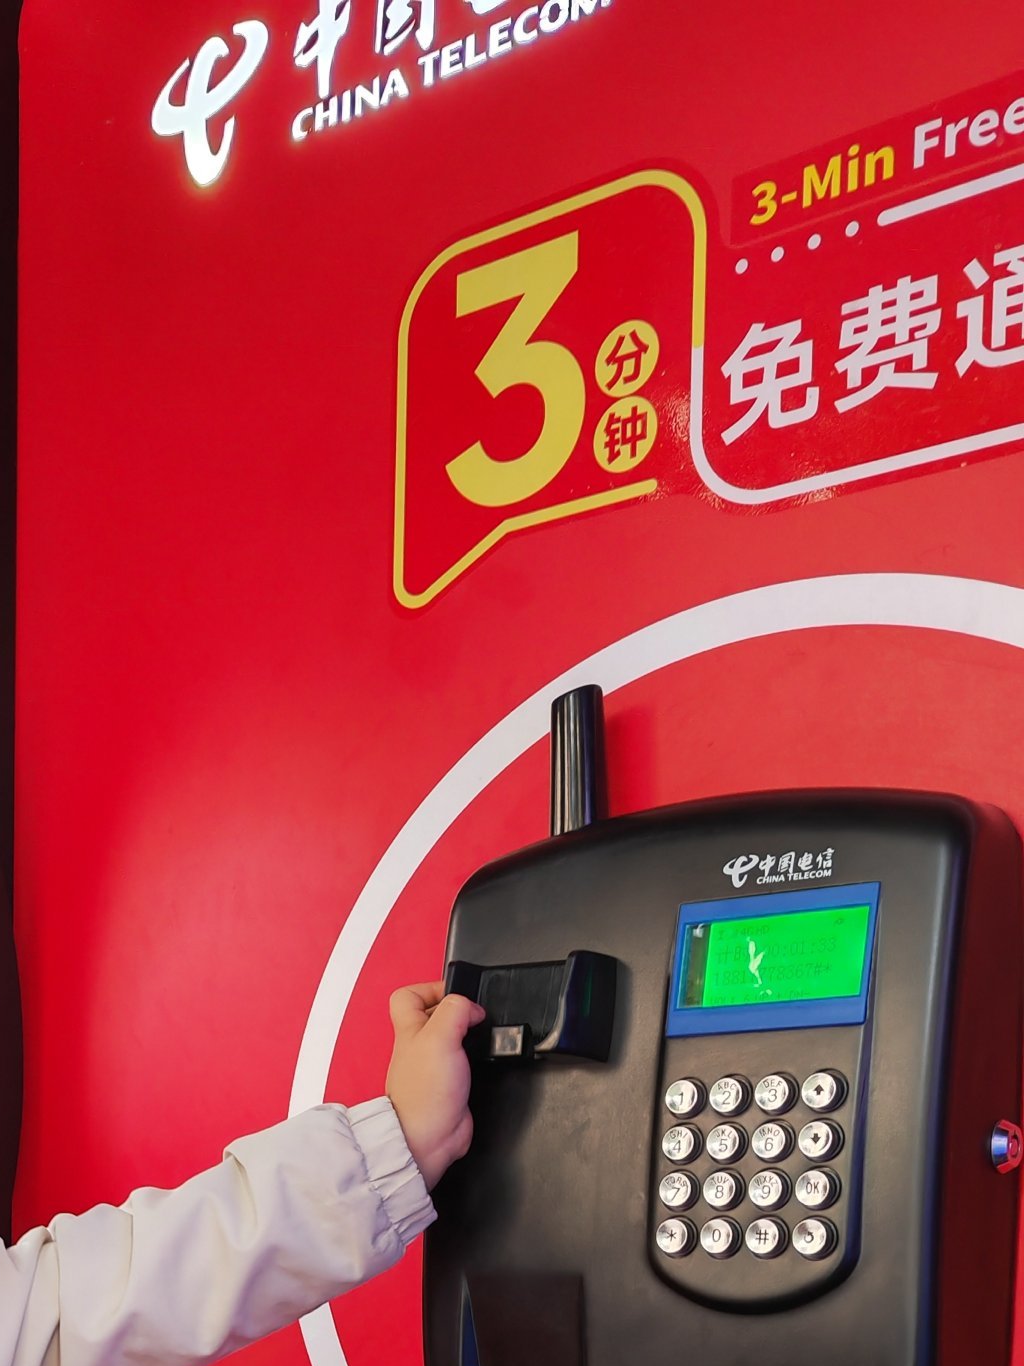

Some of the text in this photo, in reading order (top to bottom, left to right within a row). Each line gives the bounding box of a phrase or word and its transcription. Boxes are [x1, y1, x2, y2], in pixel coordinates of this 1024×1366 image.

[293, 0, 504, 97] 中国
[292, 67, 409, 141] CHINA
[749, 96, 1024, 226] 3-Min Free
[720, 244, 1024, 446] 免费通
[445, 229, 655, 508] 3 分钟
[758, 847, 835, 877] 中国电信
[756, 869, 832, 885] CHINA TELECOM
[717, 1082, 737, 1091] ABC
[763, 1079, 782, 1088] DEF
[721, 1091, 731, 1105] 2
[767, 1088, 778, 1103] 3
[669, 1129, 687, 1139] GHI
[716, 1129, 733, 1138] JKL
[759, 1128, 780, 1138] MNO
[672, 1140, 682, 1153] 4
[718, 1138, 728, 1152] 5
[764, 1137, 774, 1152] 6
[711, 1175, 729, 1184] TUV
[672, 1187, 681, 1201] 7
[714, 1185, 724, 1199] 8
[761, 1185, 772, 1200] 9
[805, 1181, 820, 1195] OK
[712, 1228, 722, 1243] 0
[755, 1229, 770, 1245] #
